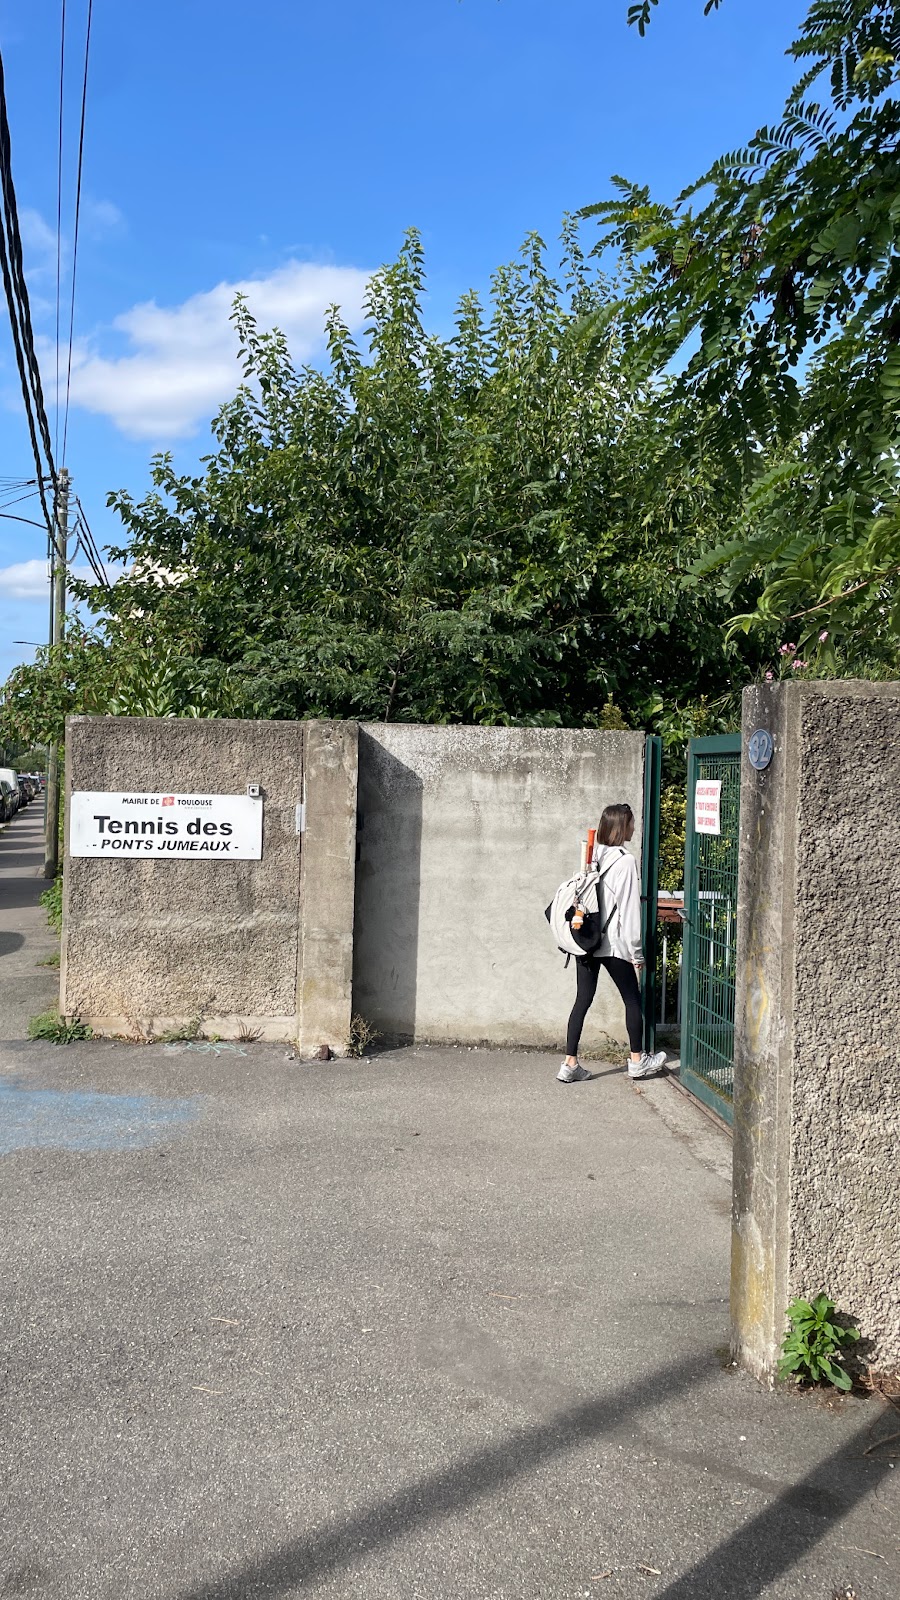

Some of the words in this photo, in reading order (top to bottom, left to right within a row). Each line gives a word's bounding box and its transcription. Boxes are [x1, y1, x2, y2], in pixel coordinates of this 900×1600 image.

[752, 735, 769, 762] 32
[122, 797, 148, 805] MAIRIE
[94, 815, 178, 835] Tennis
[186, 818, 233, 836] des
[101, 839, 153, 850] PONTS
[158, 840, 232, 852] JUMEAUX
